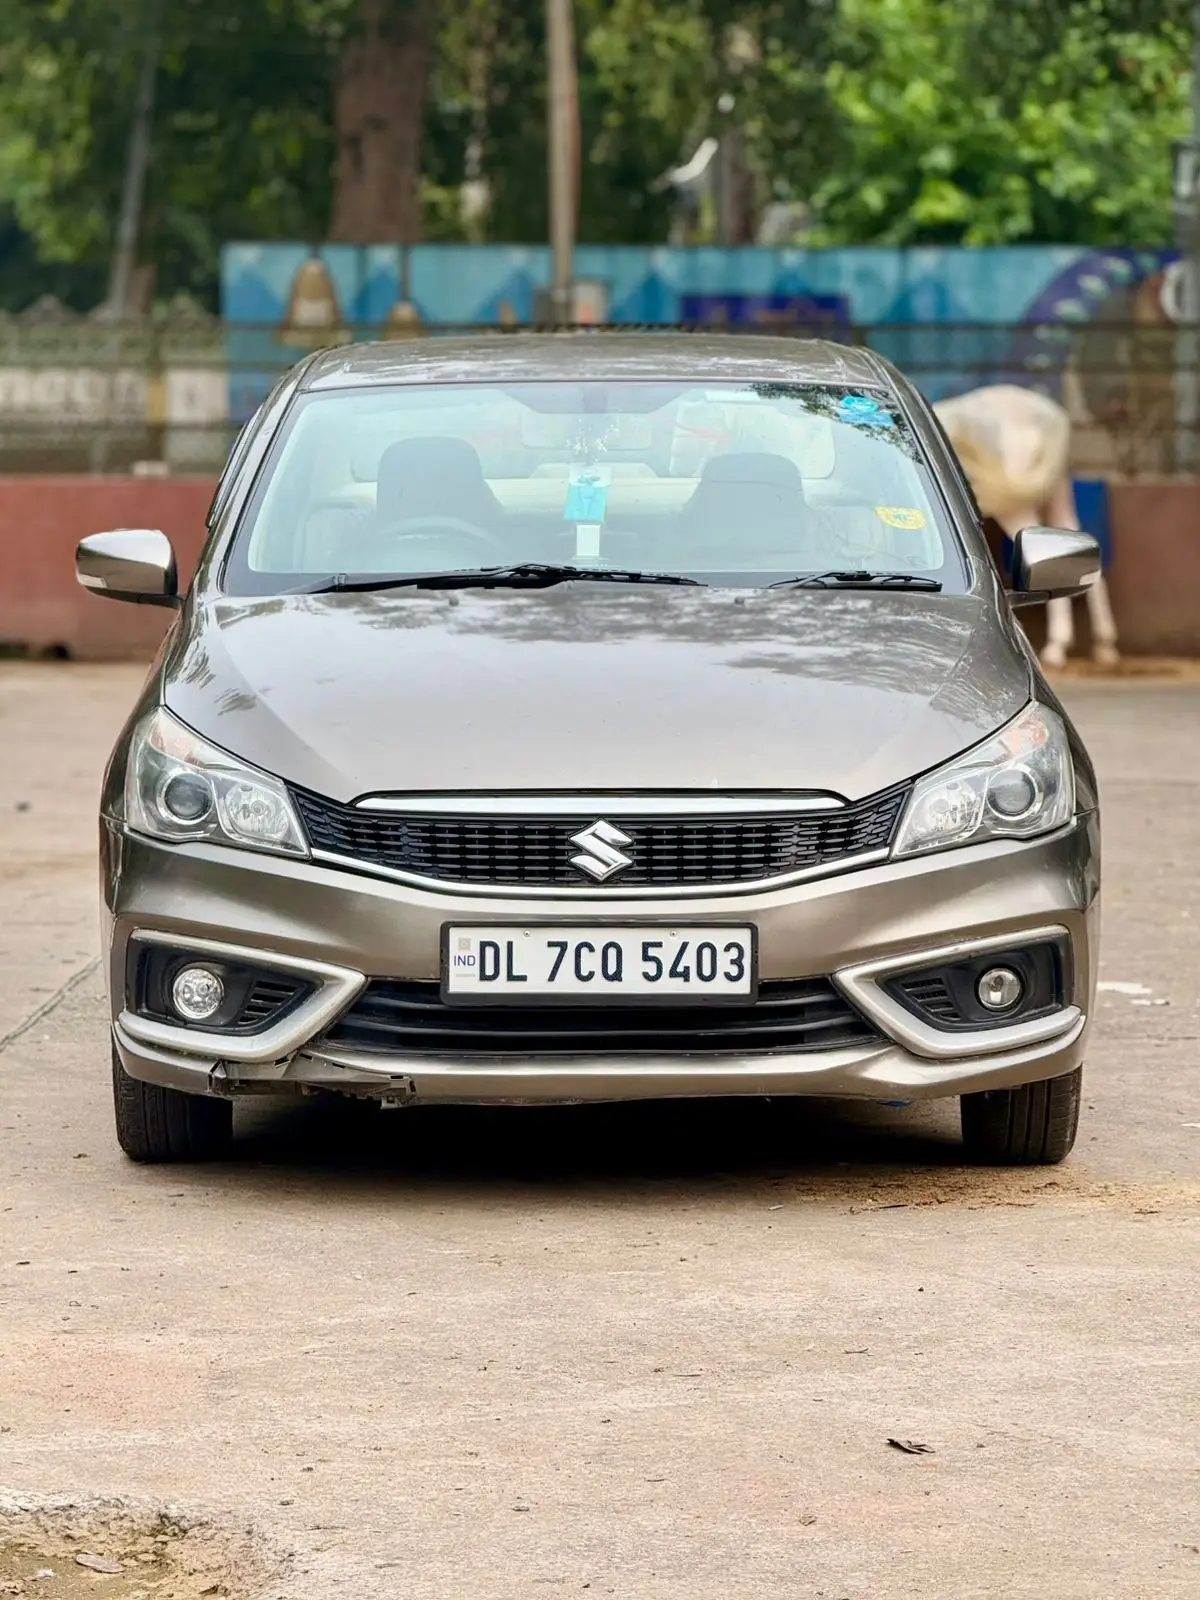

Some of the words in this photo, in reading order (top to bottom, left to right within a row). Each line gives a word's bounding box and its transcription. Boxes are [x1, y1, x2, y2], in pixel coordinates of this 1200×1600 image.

[453, 954, 476, 967] IND
[479, 940, 528, 982] DL
[546, 940, 623, 983] 7CQ
[641, 940, 745, 983] 5403
